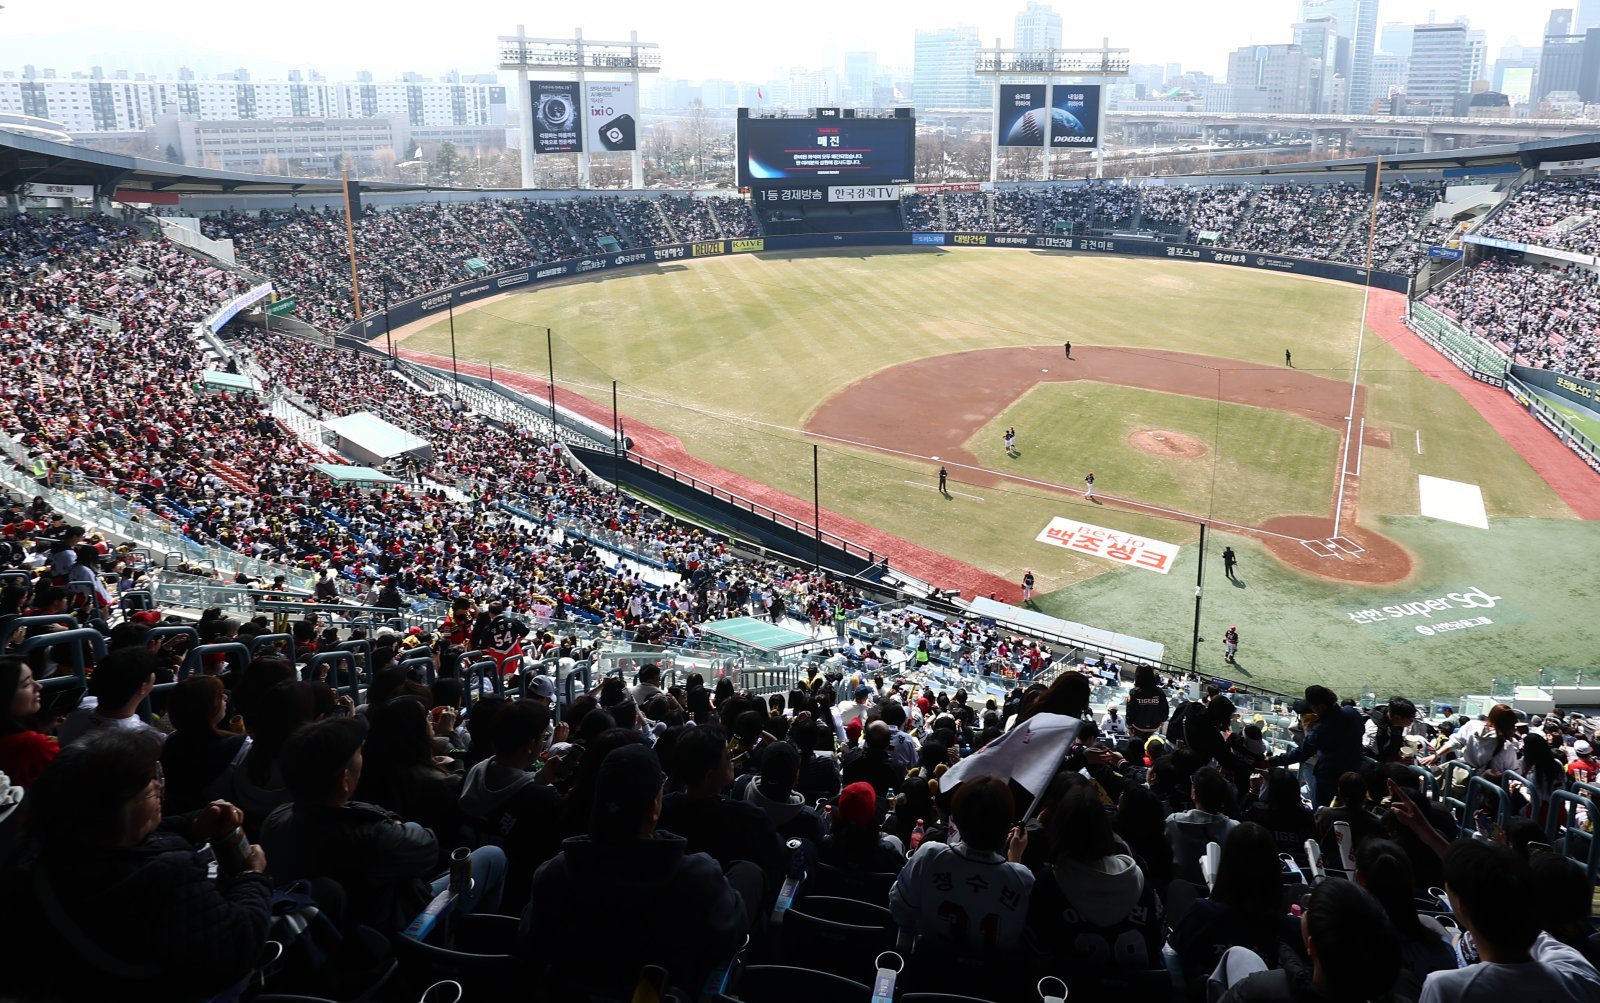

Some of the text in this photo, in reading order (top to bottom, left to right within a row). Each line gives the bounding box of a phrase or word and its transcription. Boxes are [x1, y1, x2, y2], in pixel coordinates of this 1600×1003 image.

[760, 189, 823, 201] 1등 경제방송
[835, 187, 894, 200] 한국경제TV
[954, 235, 986, 244] 대방건설
[1045, 237, 1073, 248] 대보건설
[1080, 239, 1114, 251] 금천미트
[654, 248, 684, 260] 현대해상
[696, 242, 720, 254] REUZEL
[1046, 527, 1168, 570] 백조씽크
[1347, 608, 1388, 624] 신한
[1382, 596, 1454, 618] super
[1433, 616, 1494, 632] 신한금융그룹
[494, 630, 512, 647] 54
[932, 872, 1020, 911] 정수빈
